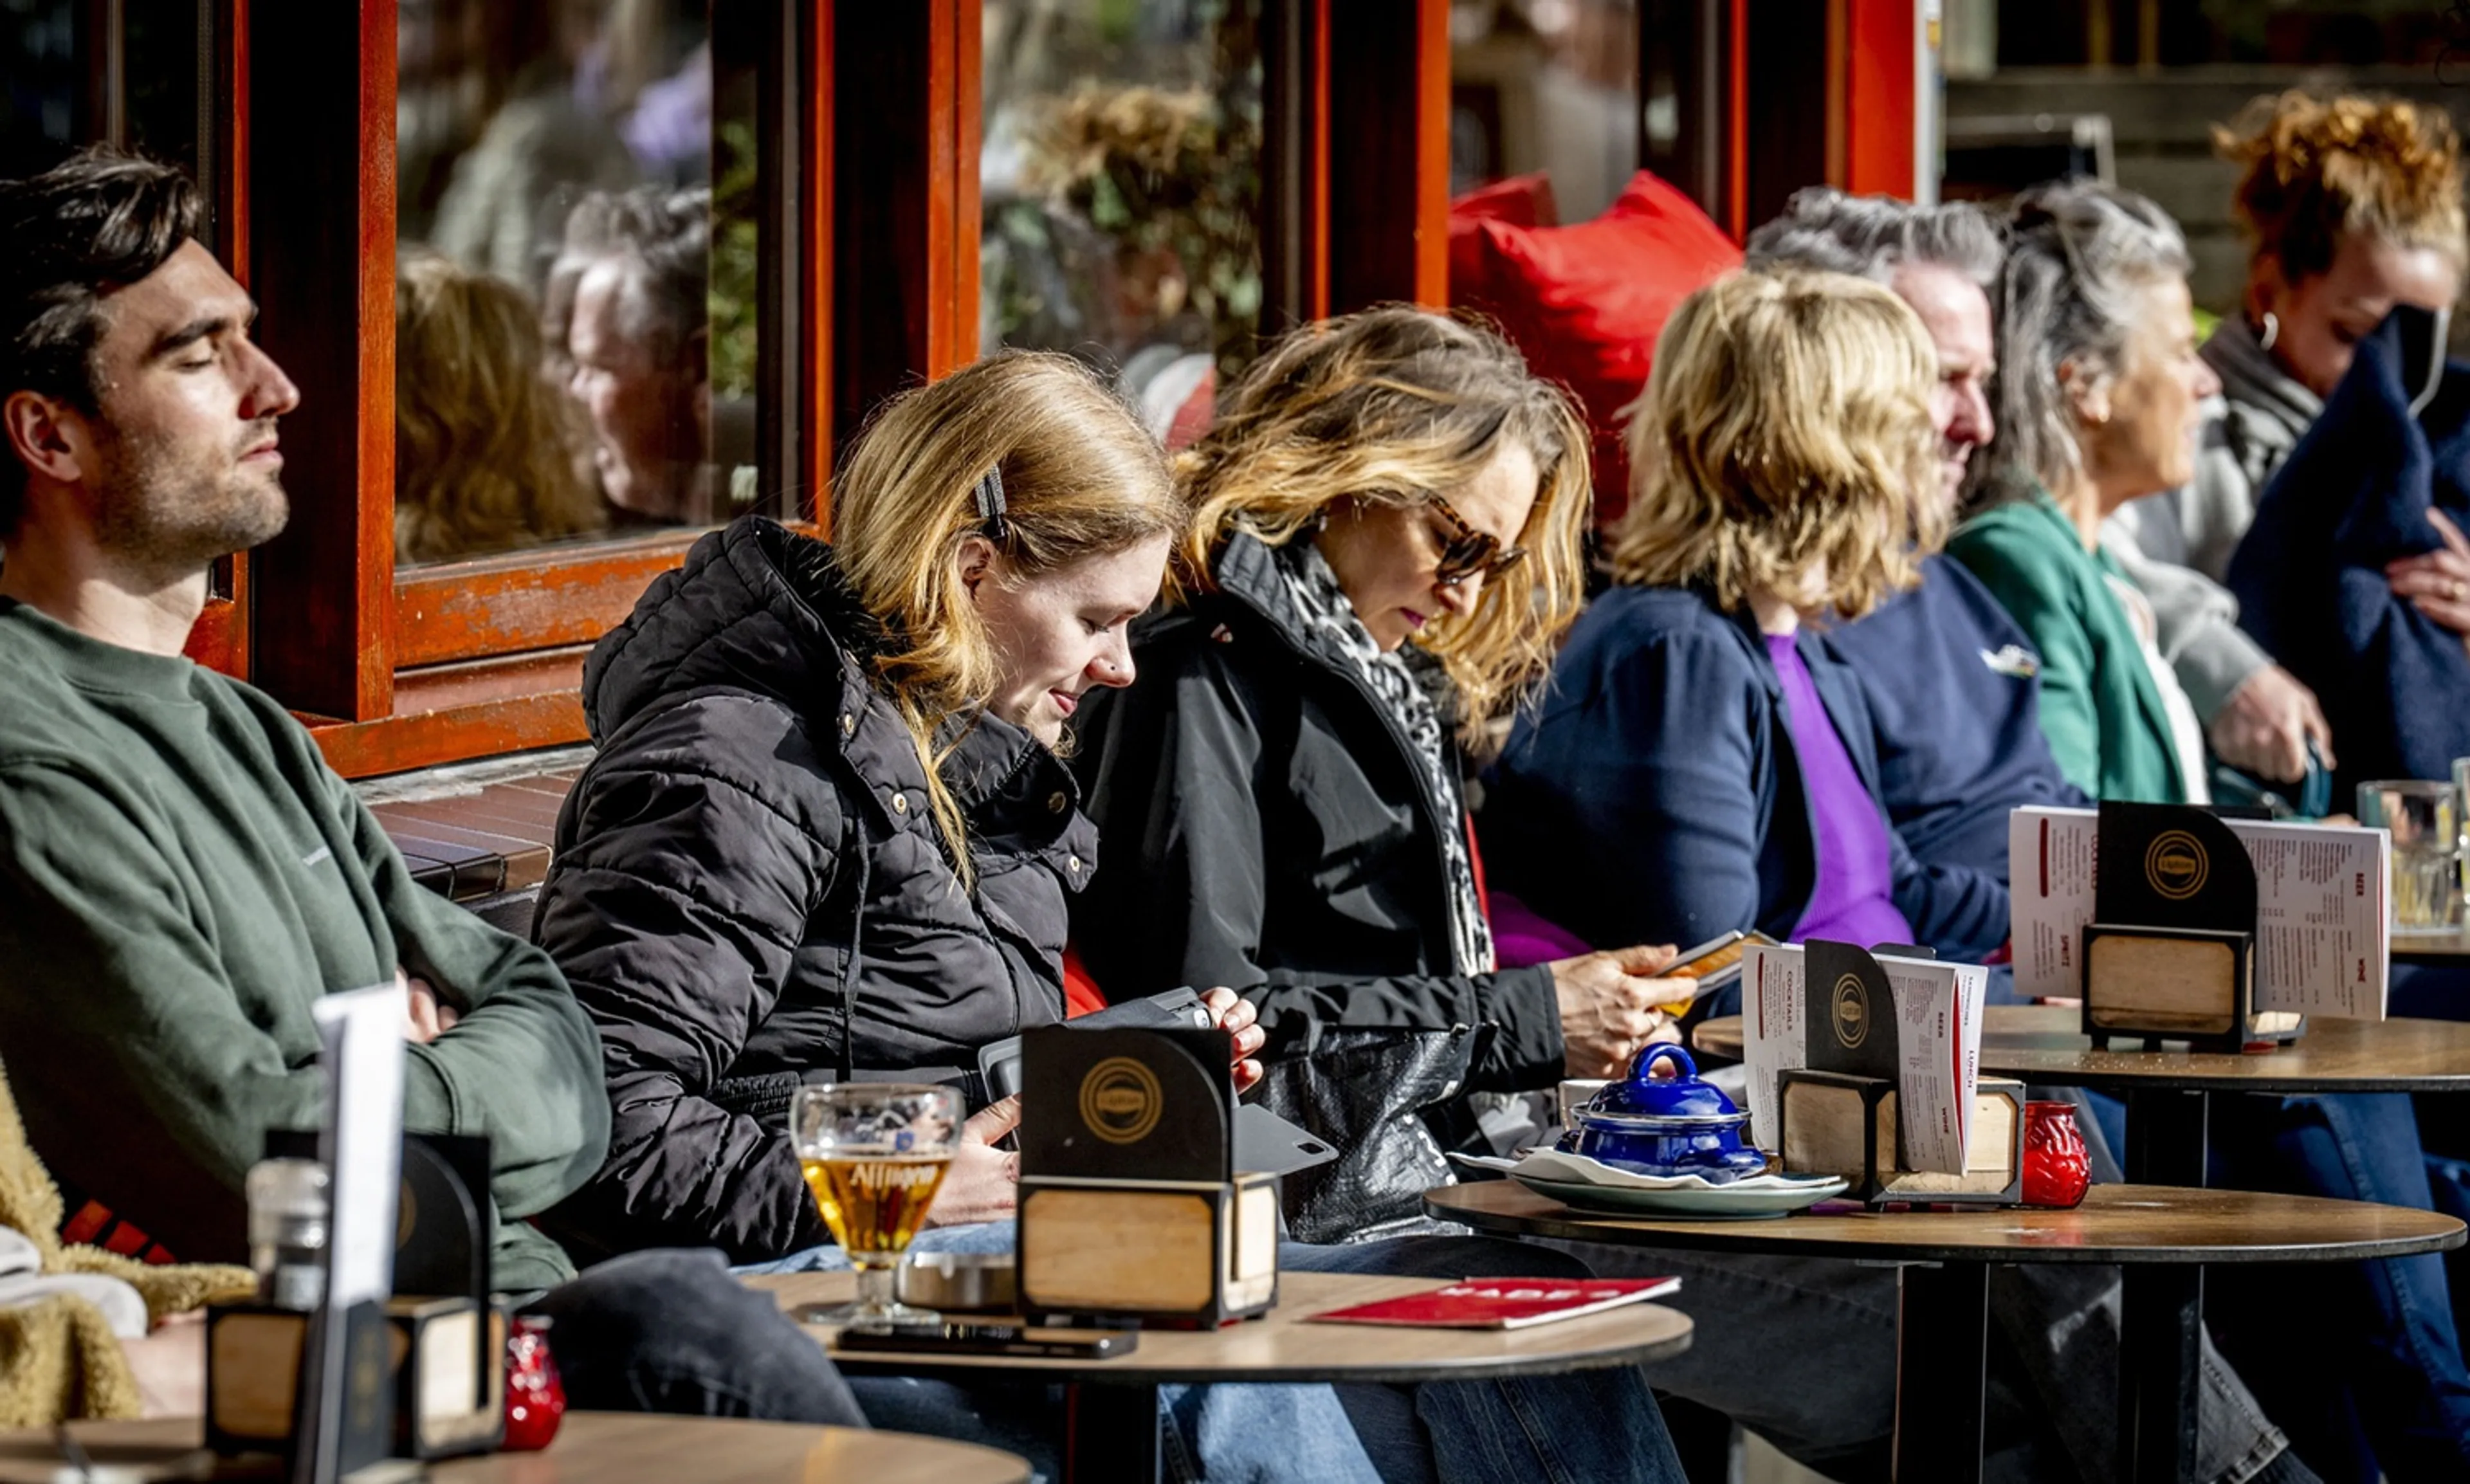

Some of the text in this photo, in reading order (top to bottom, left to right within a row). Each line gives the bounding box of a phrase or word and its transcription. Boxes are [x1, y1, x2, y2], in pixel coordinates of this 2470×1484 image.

[2356, 872, 2365, 897] BEER
[2060, 935, 2070, 967] SPRITZ
[2357, 957, 2366, 983] WINE
